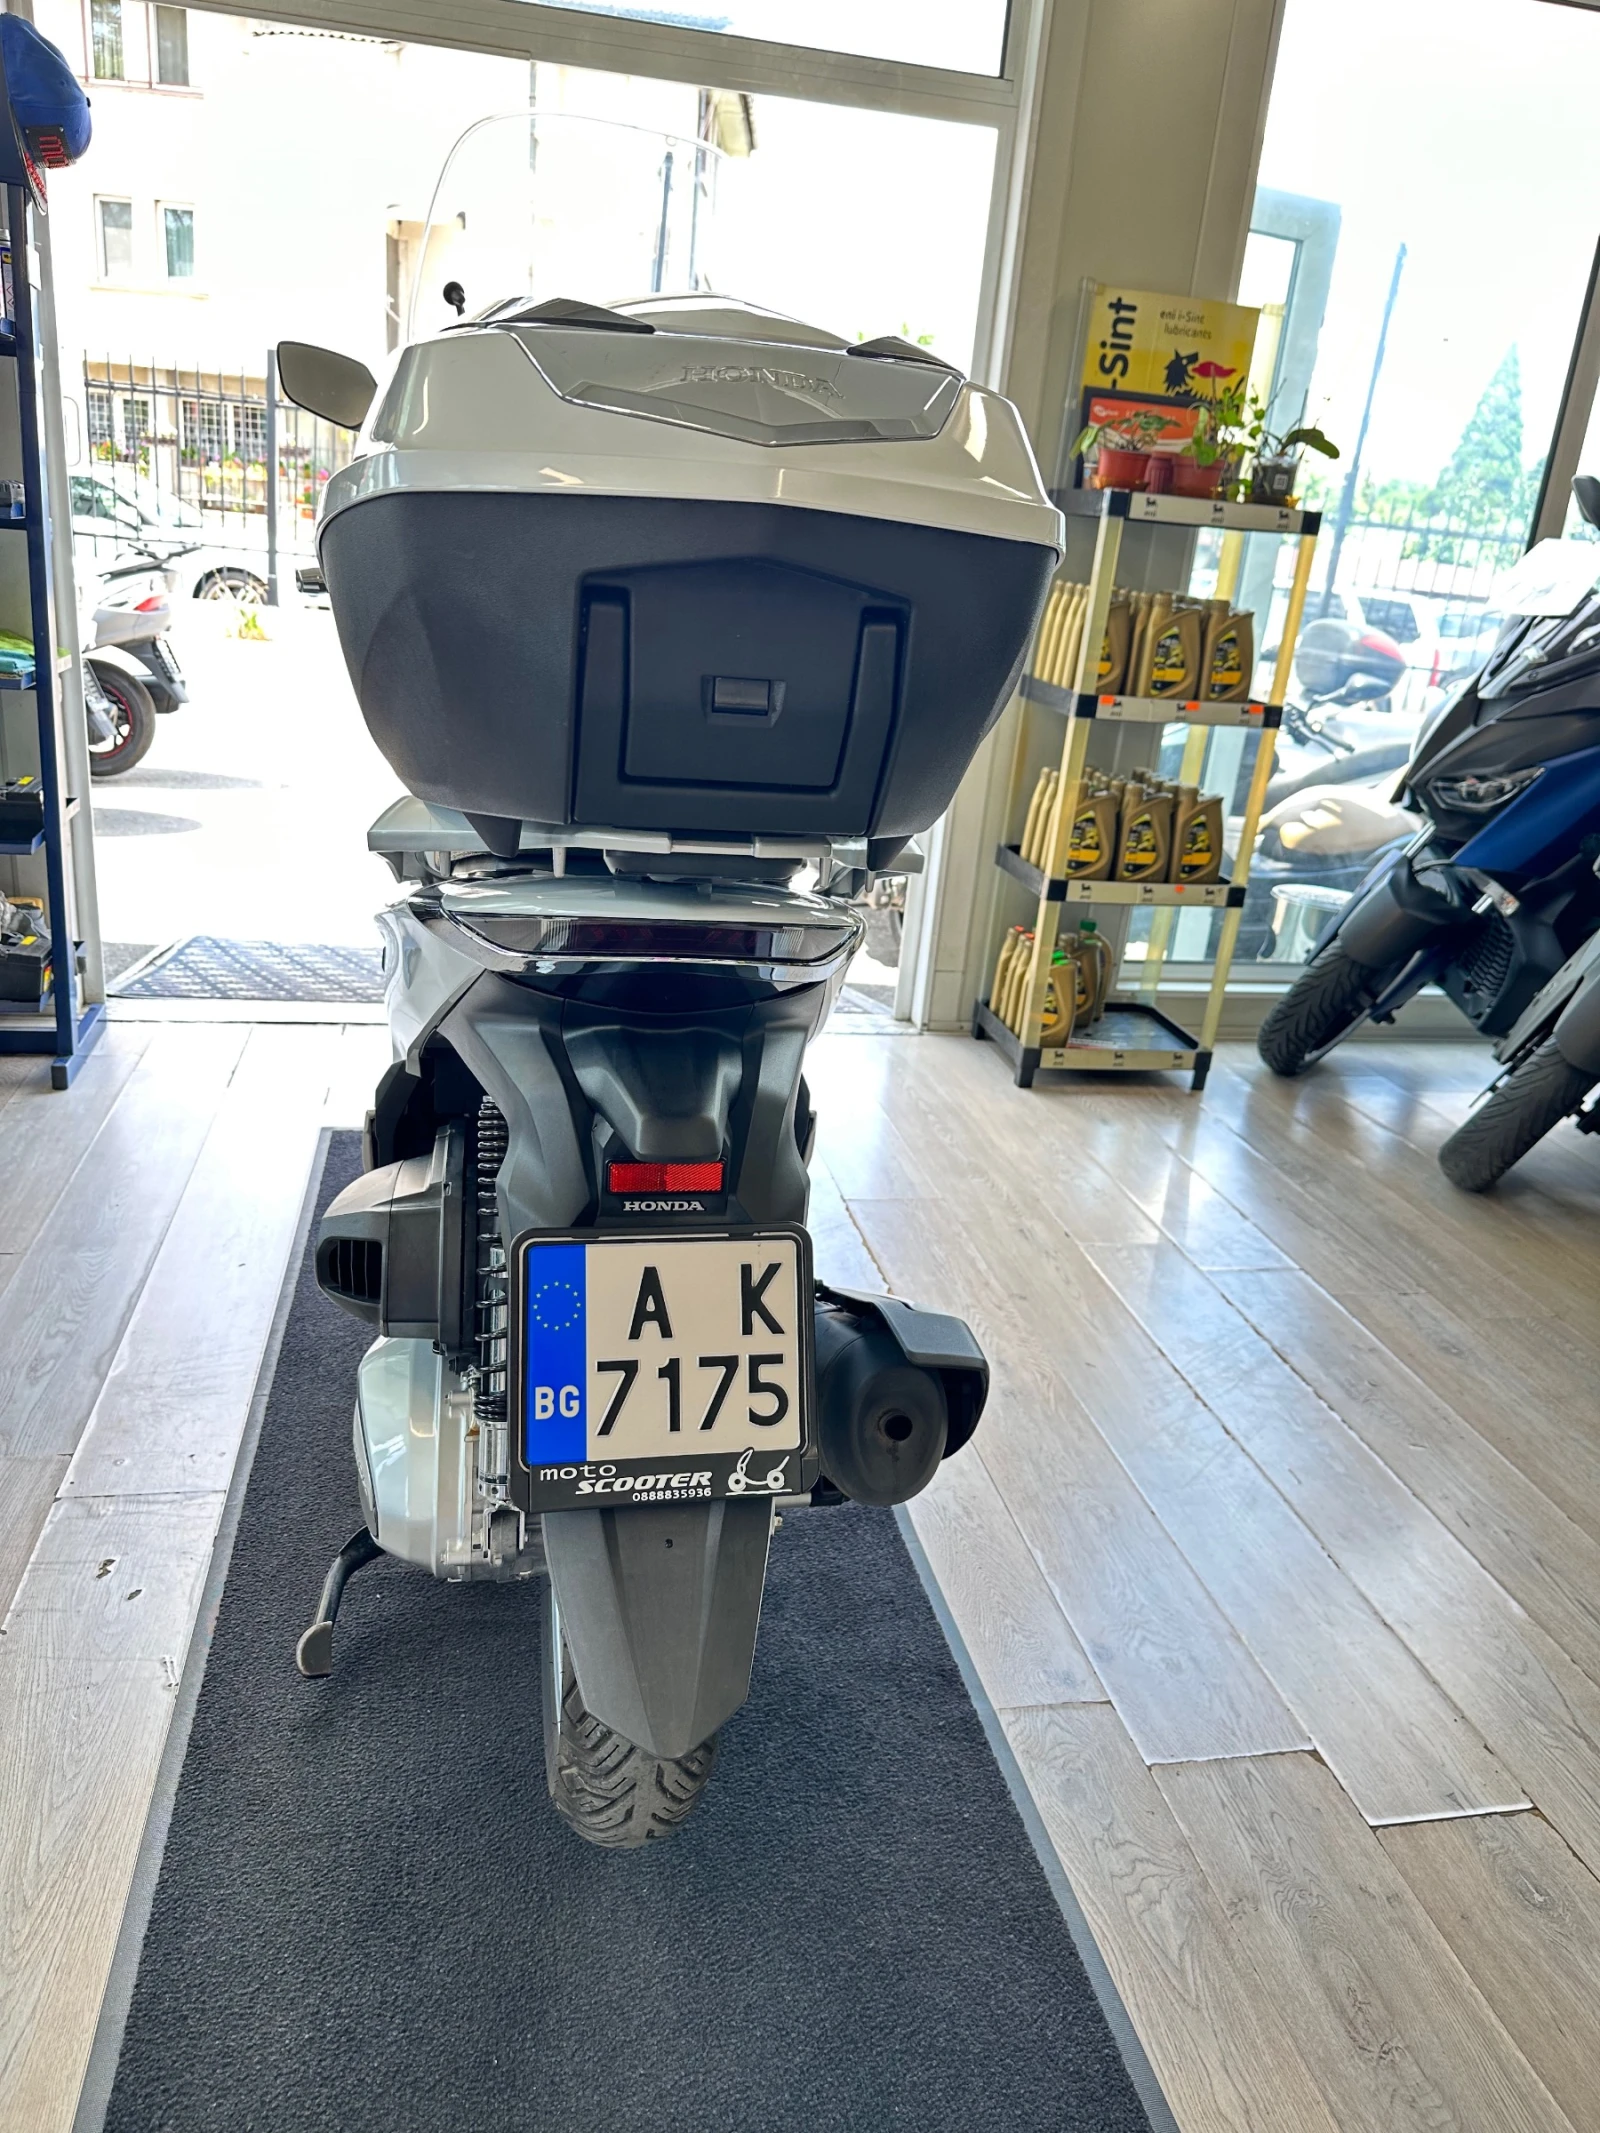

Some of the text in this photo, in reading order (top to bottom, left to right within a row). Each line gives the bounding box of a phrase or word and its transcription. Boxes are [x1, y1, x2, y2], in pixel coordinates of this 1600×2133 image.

[681, 364, 845, 400] HONDA
[623, 1201, 705, 1212] HONDA
[628, 1262, 786, 1340] A K
[534, 1385, 581, 1420] BG
[596, 1353, 790, 1436] 7175
[540, 1464, 617, 1482] moto
[575, 1471, 713, 1495] SCOOTER
[632, 1487, 712, 1502] 0888835936
